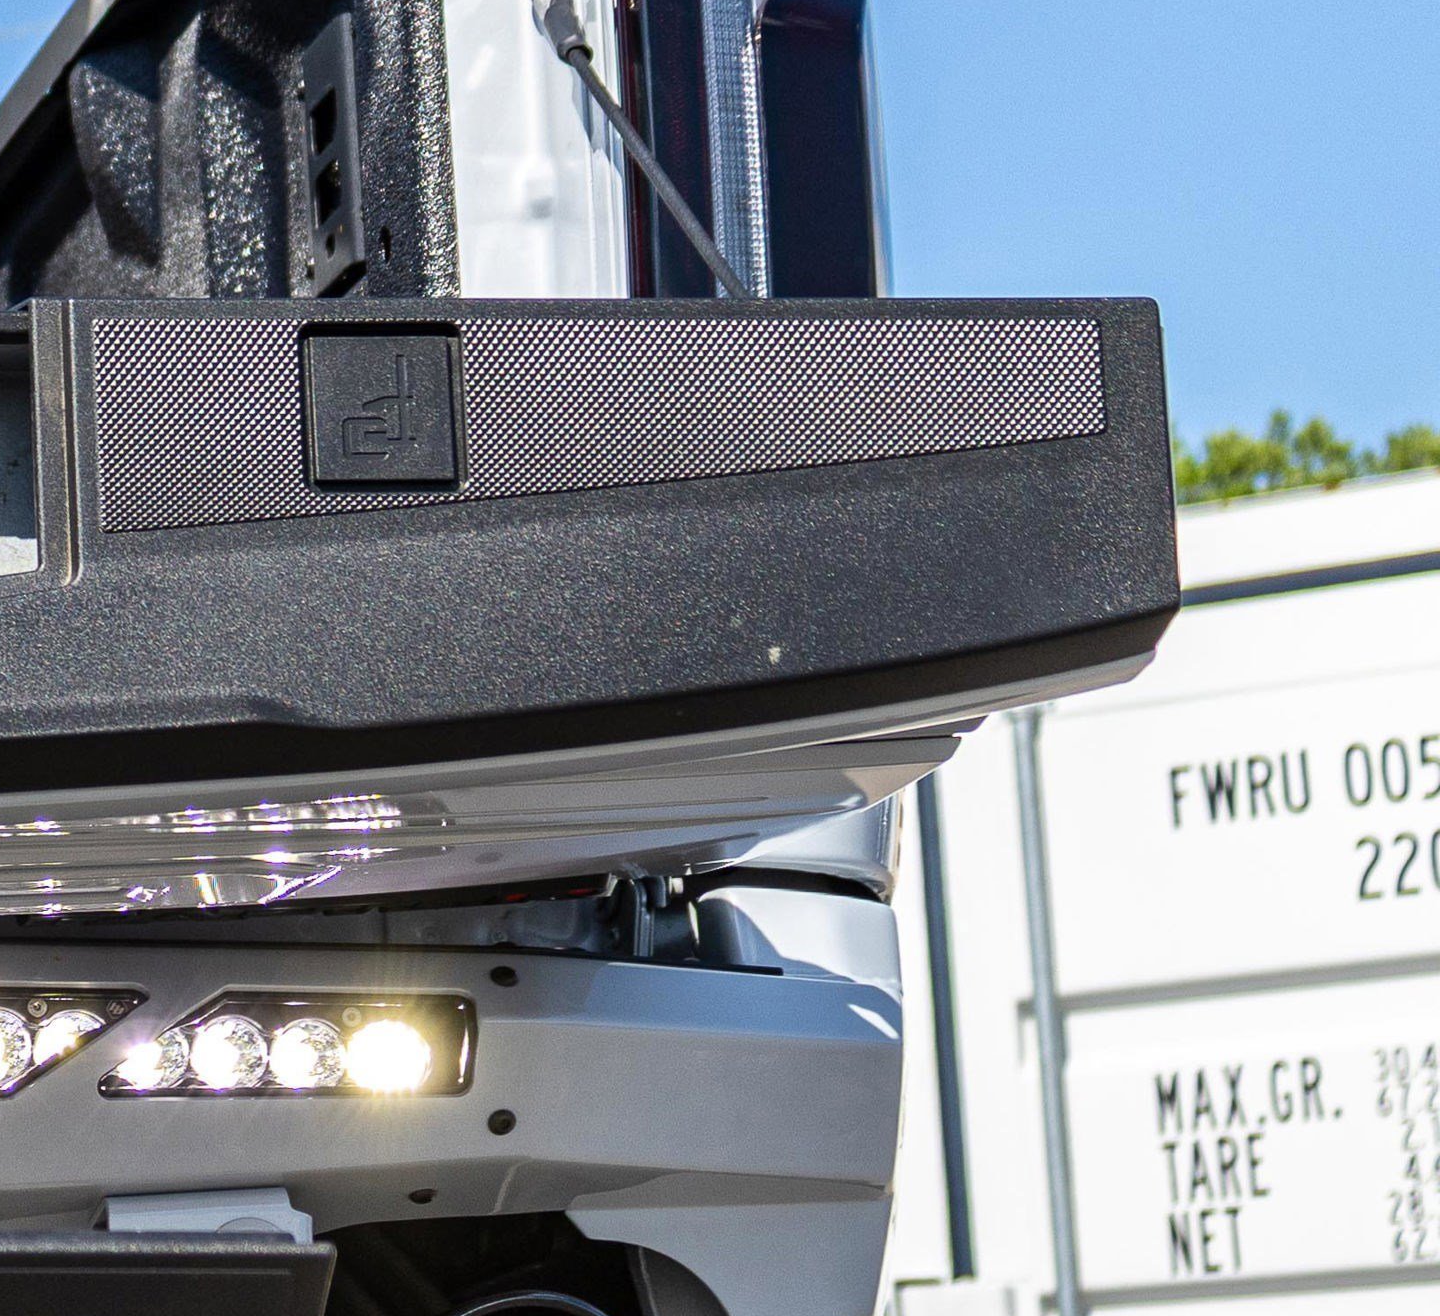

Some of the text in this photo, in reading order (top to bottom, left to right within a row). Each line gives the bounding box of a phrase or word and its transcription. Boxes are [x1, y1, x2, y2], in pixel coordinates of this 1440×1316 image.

[1168, 733, 1440, 830] FWRU 005
[1161, 1132, 1272, 1204] TARE
[1168, 1205, 1245, 1278] NET
